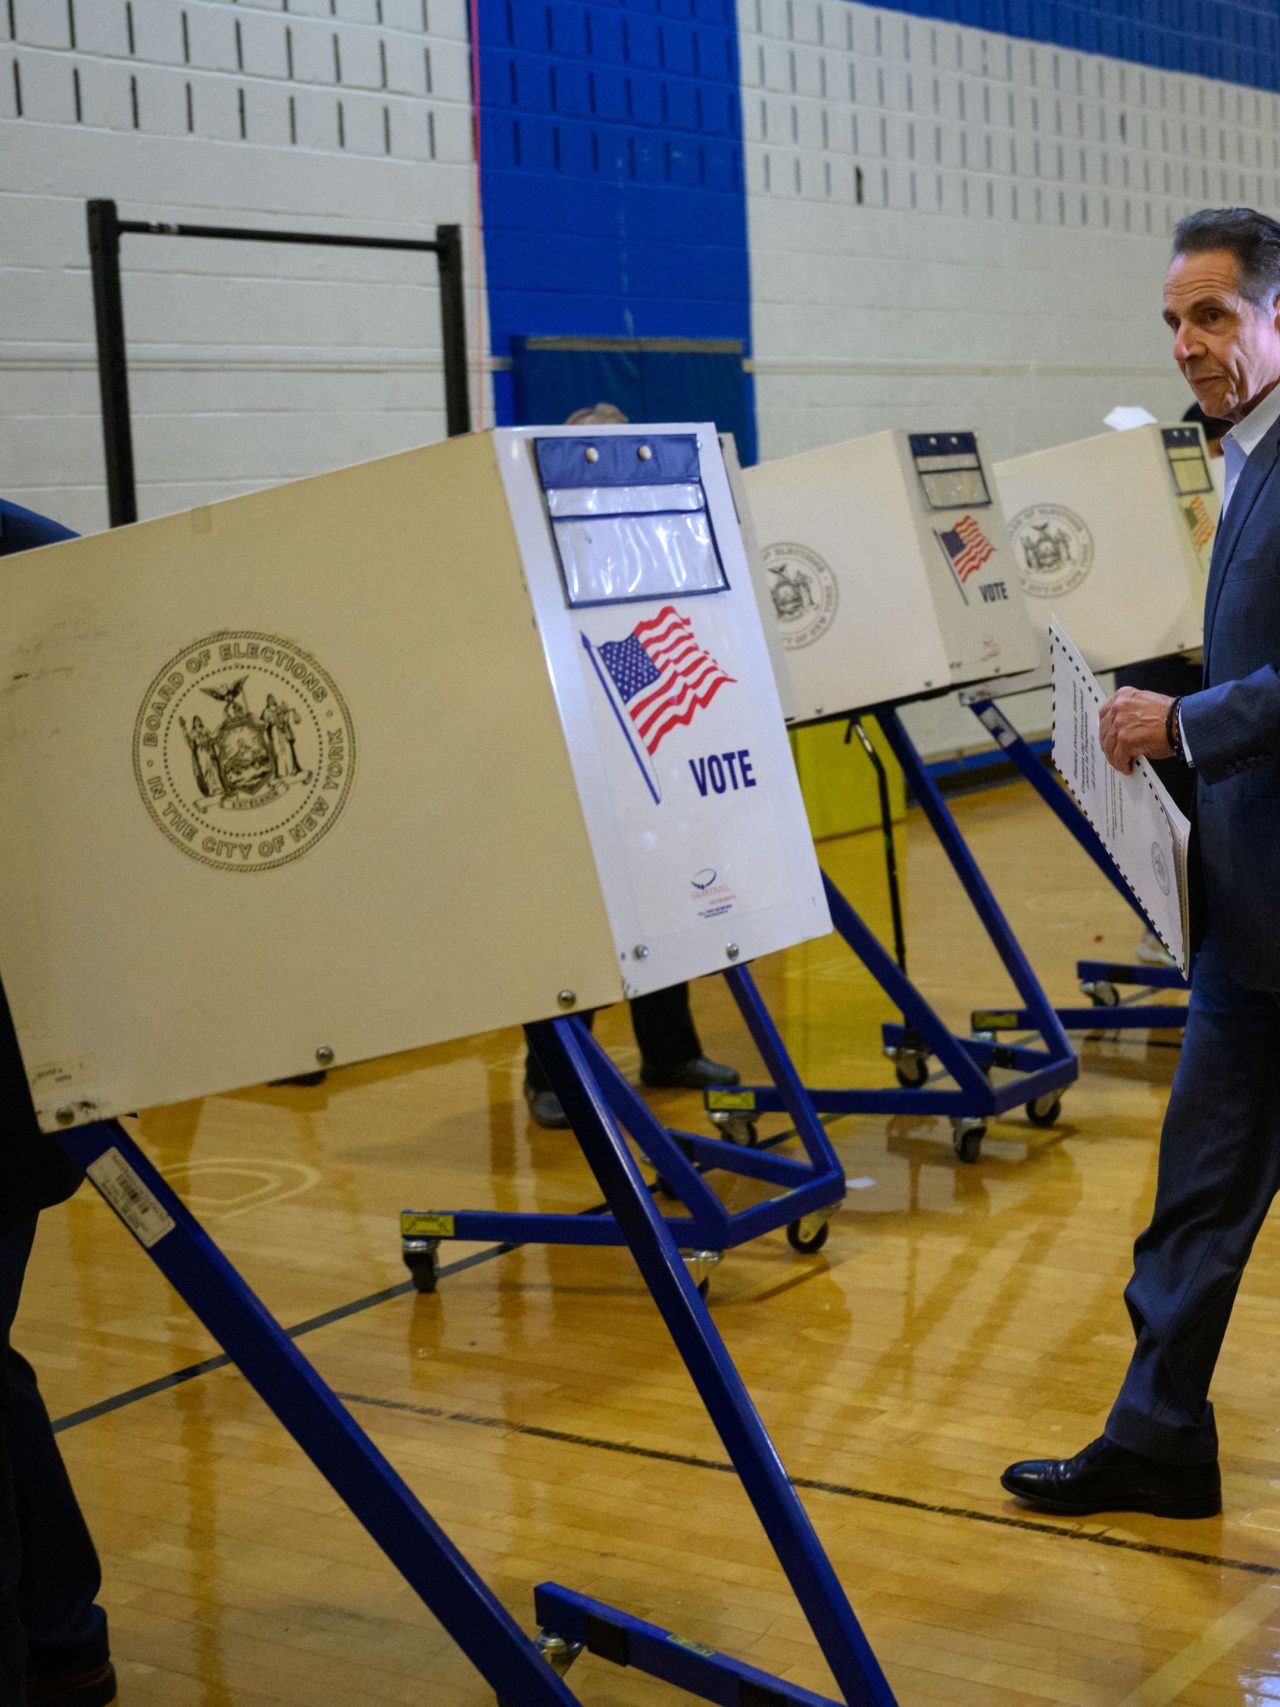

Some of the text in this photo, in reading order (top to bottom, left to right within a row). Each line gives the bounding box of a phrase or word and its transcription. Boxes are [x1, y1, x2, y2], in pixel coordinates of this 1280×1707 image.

[979, 582, 1008, 603] VOTE
[143, 642, 328, 747] BOARD OF ELECTIONS
[147, 727, 344, 860] IN THE CITY OF NEW YORK
[688, 749, 757, 797] VOTE
